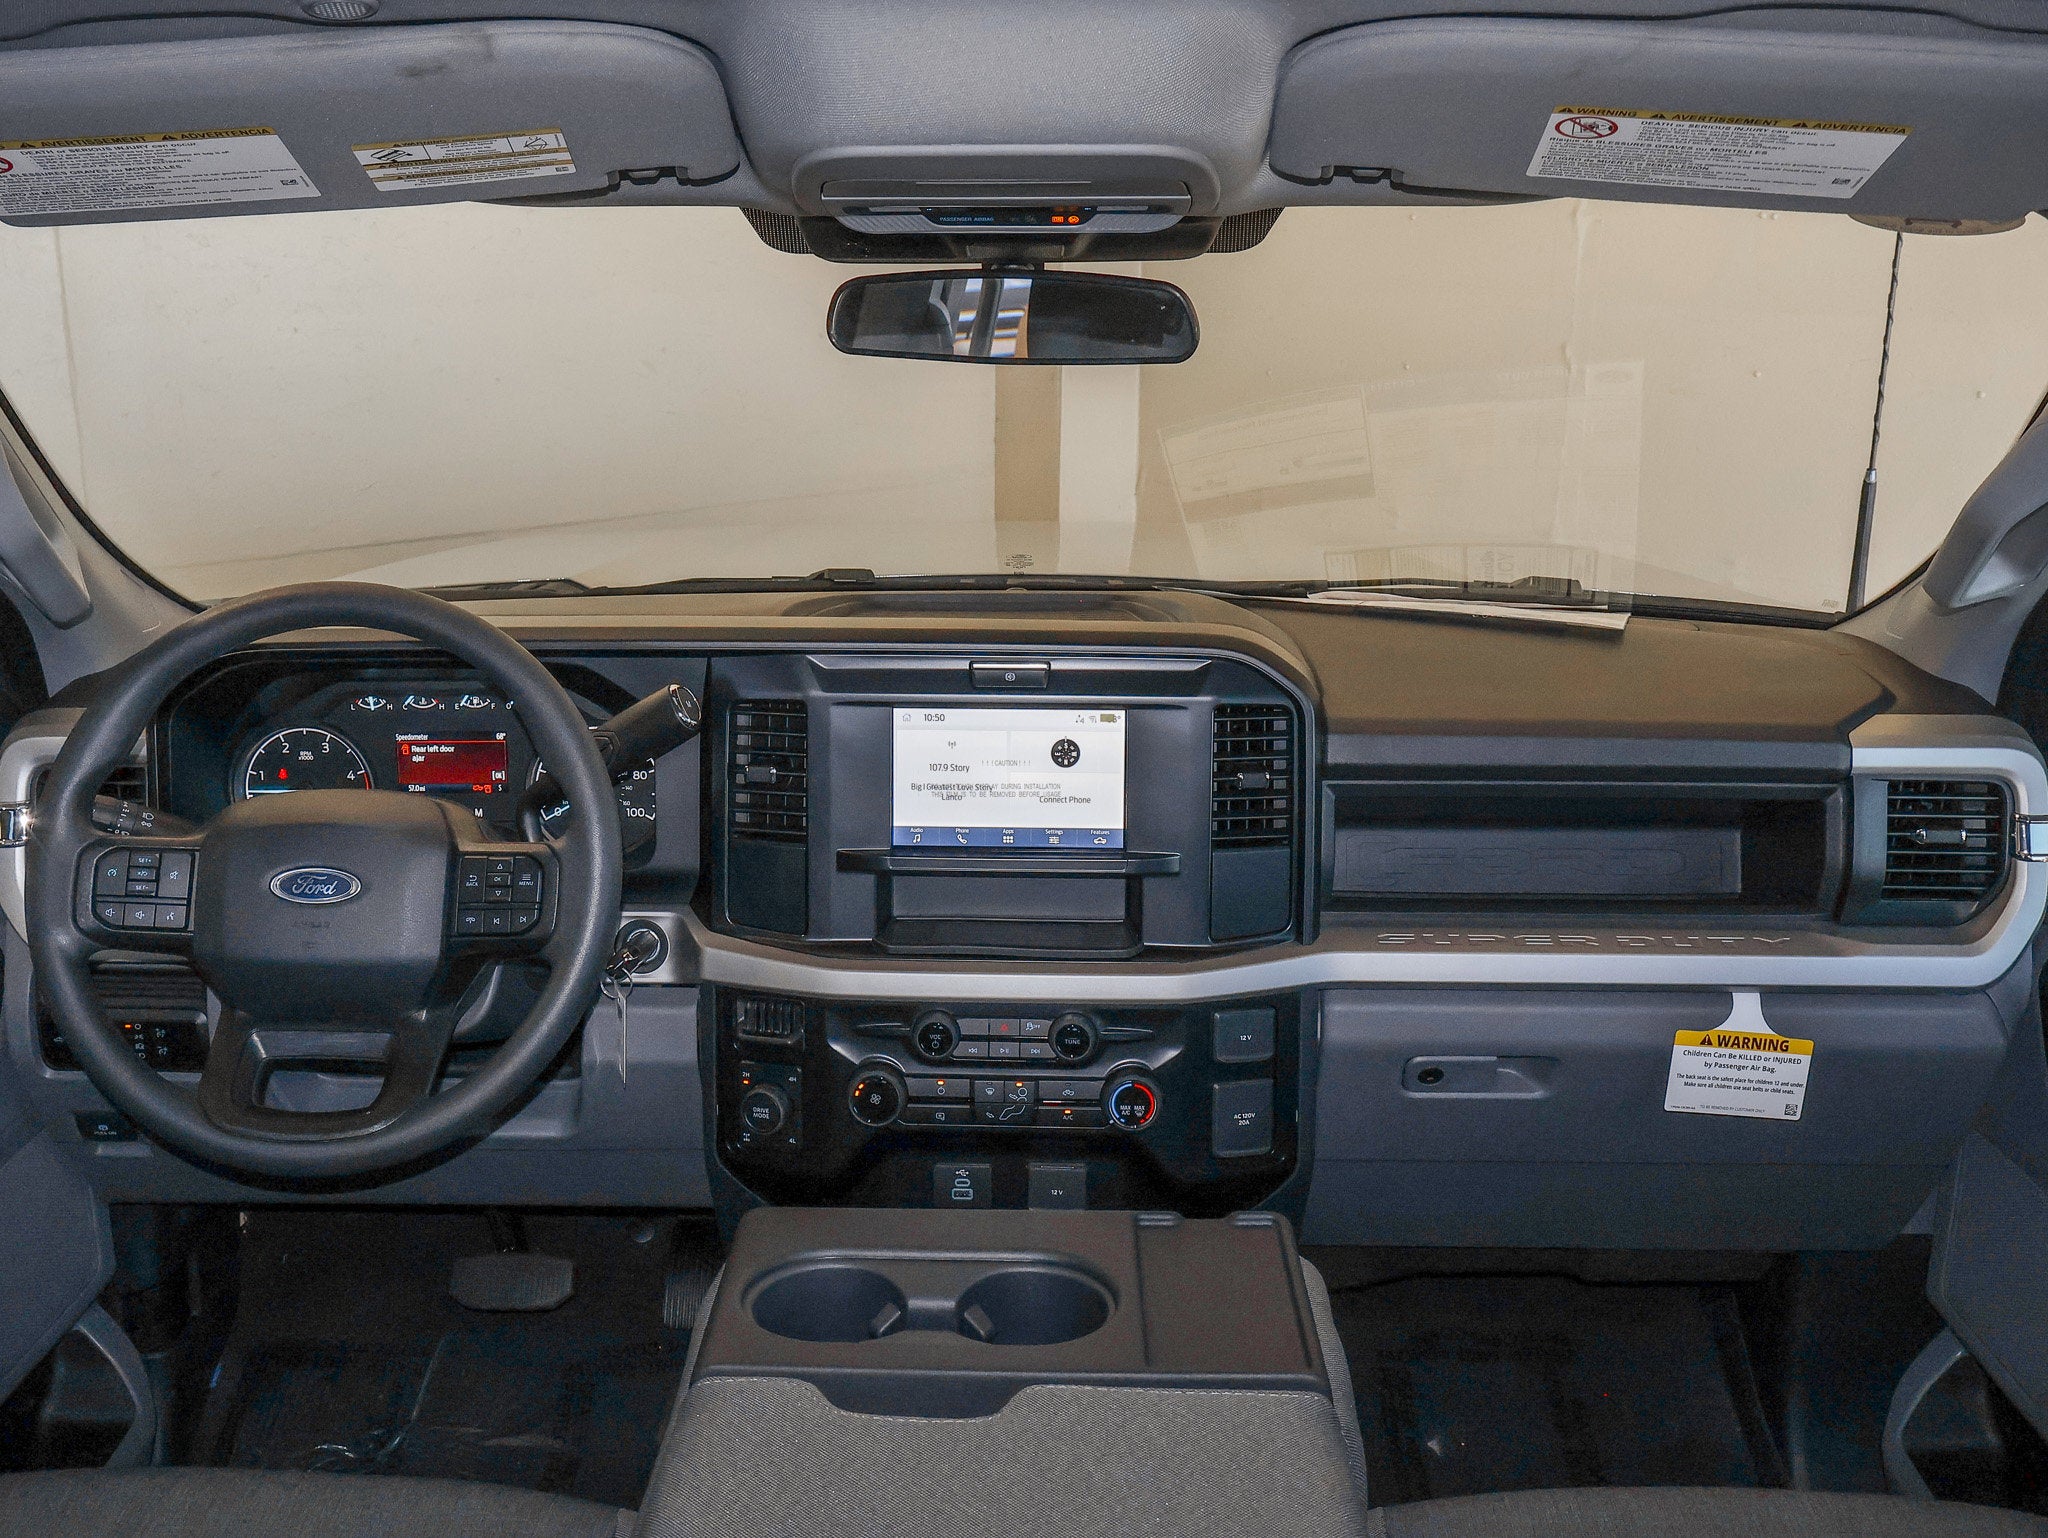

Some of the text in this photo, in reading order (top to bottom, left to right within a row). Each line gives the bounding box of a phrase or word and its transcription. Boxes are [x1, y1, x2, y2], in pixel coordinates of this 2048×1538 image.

[1577, 108, 1907, 134] WARNING AVERTISSEMENT ADVERTENCIA
[41, 128, 270, 148] AVERTISSEMENT ADVERTENCIA
[924, 714, 945, 722] 10:50
[282, 743, 329, 753] 2 3
[412, 755, 425, 763] ajar
[929, 763, 970, 773] 107.9 Story
[260, 771, 355, 780] 1 4
[633, 771, 647, 780] 80
[1040, 796, 1067, 804] Connect
[1069, 796, 1091, 804] Phone
[475, 808, 483, 817] M
[626, 808, 645, 817] 100
[292, 874, 338, 895] Ford
[1717, 1034, 1790, 1052] WARNING
[1683, 1050, 1712, 1058] Children
[1773, 1056, 1802, 1064] INJURED
[1704, 1061, 1713, 1069] by
[1714, 1062, 1749, 1071] Passenger
[1762, 1066, 1776, 1074] Bag.
